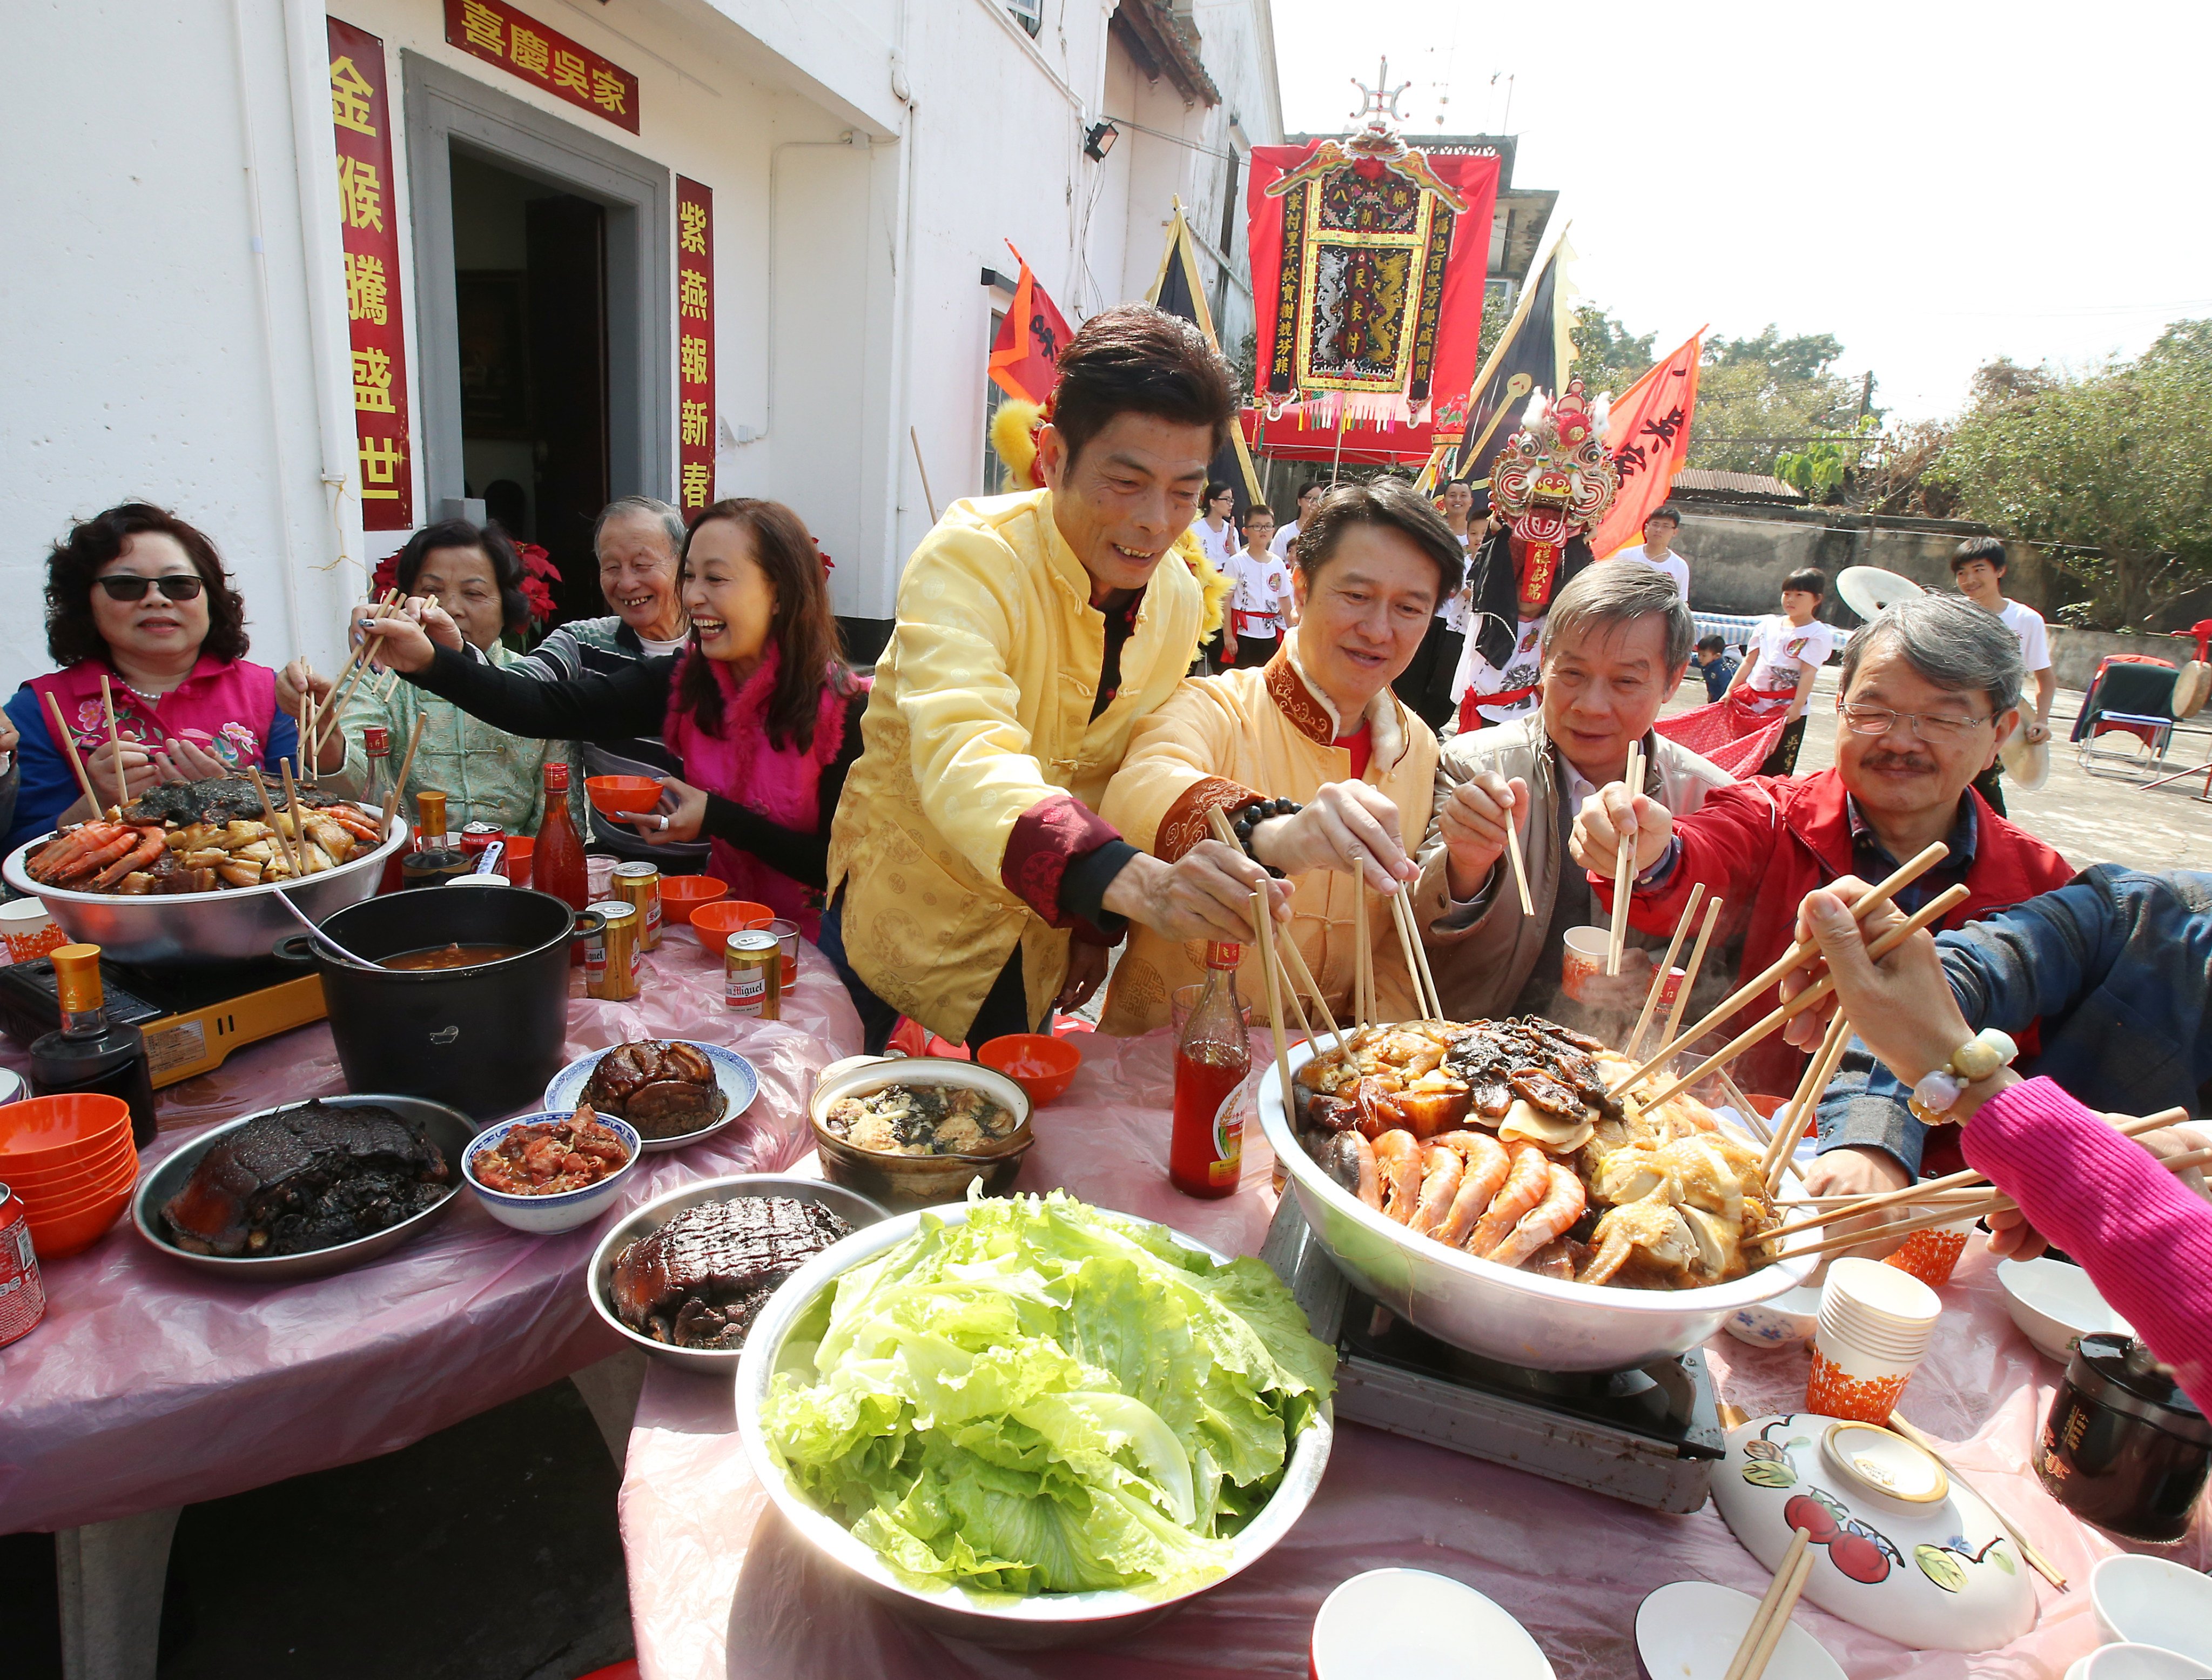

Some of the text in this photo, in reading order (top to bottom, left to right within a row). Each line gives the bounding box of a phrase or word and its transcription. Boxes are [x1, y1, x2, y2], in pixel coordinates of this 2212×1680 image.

[461, 0, 626, 115] 喜慶吳家
[330, 55, 399, 499] 金猴騰盛世
[680, 201, 708, 508] 紫燕報新春
[1274, 185, 1302, 374] 家村里千秋寶樹競芬菲
[733, 982, 764, 997] Miguel
